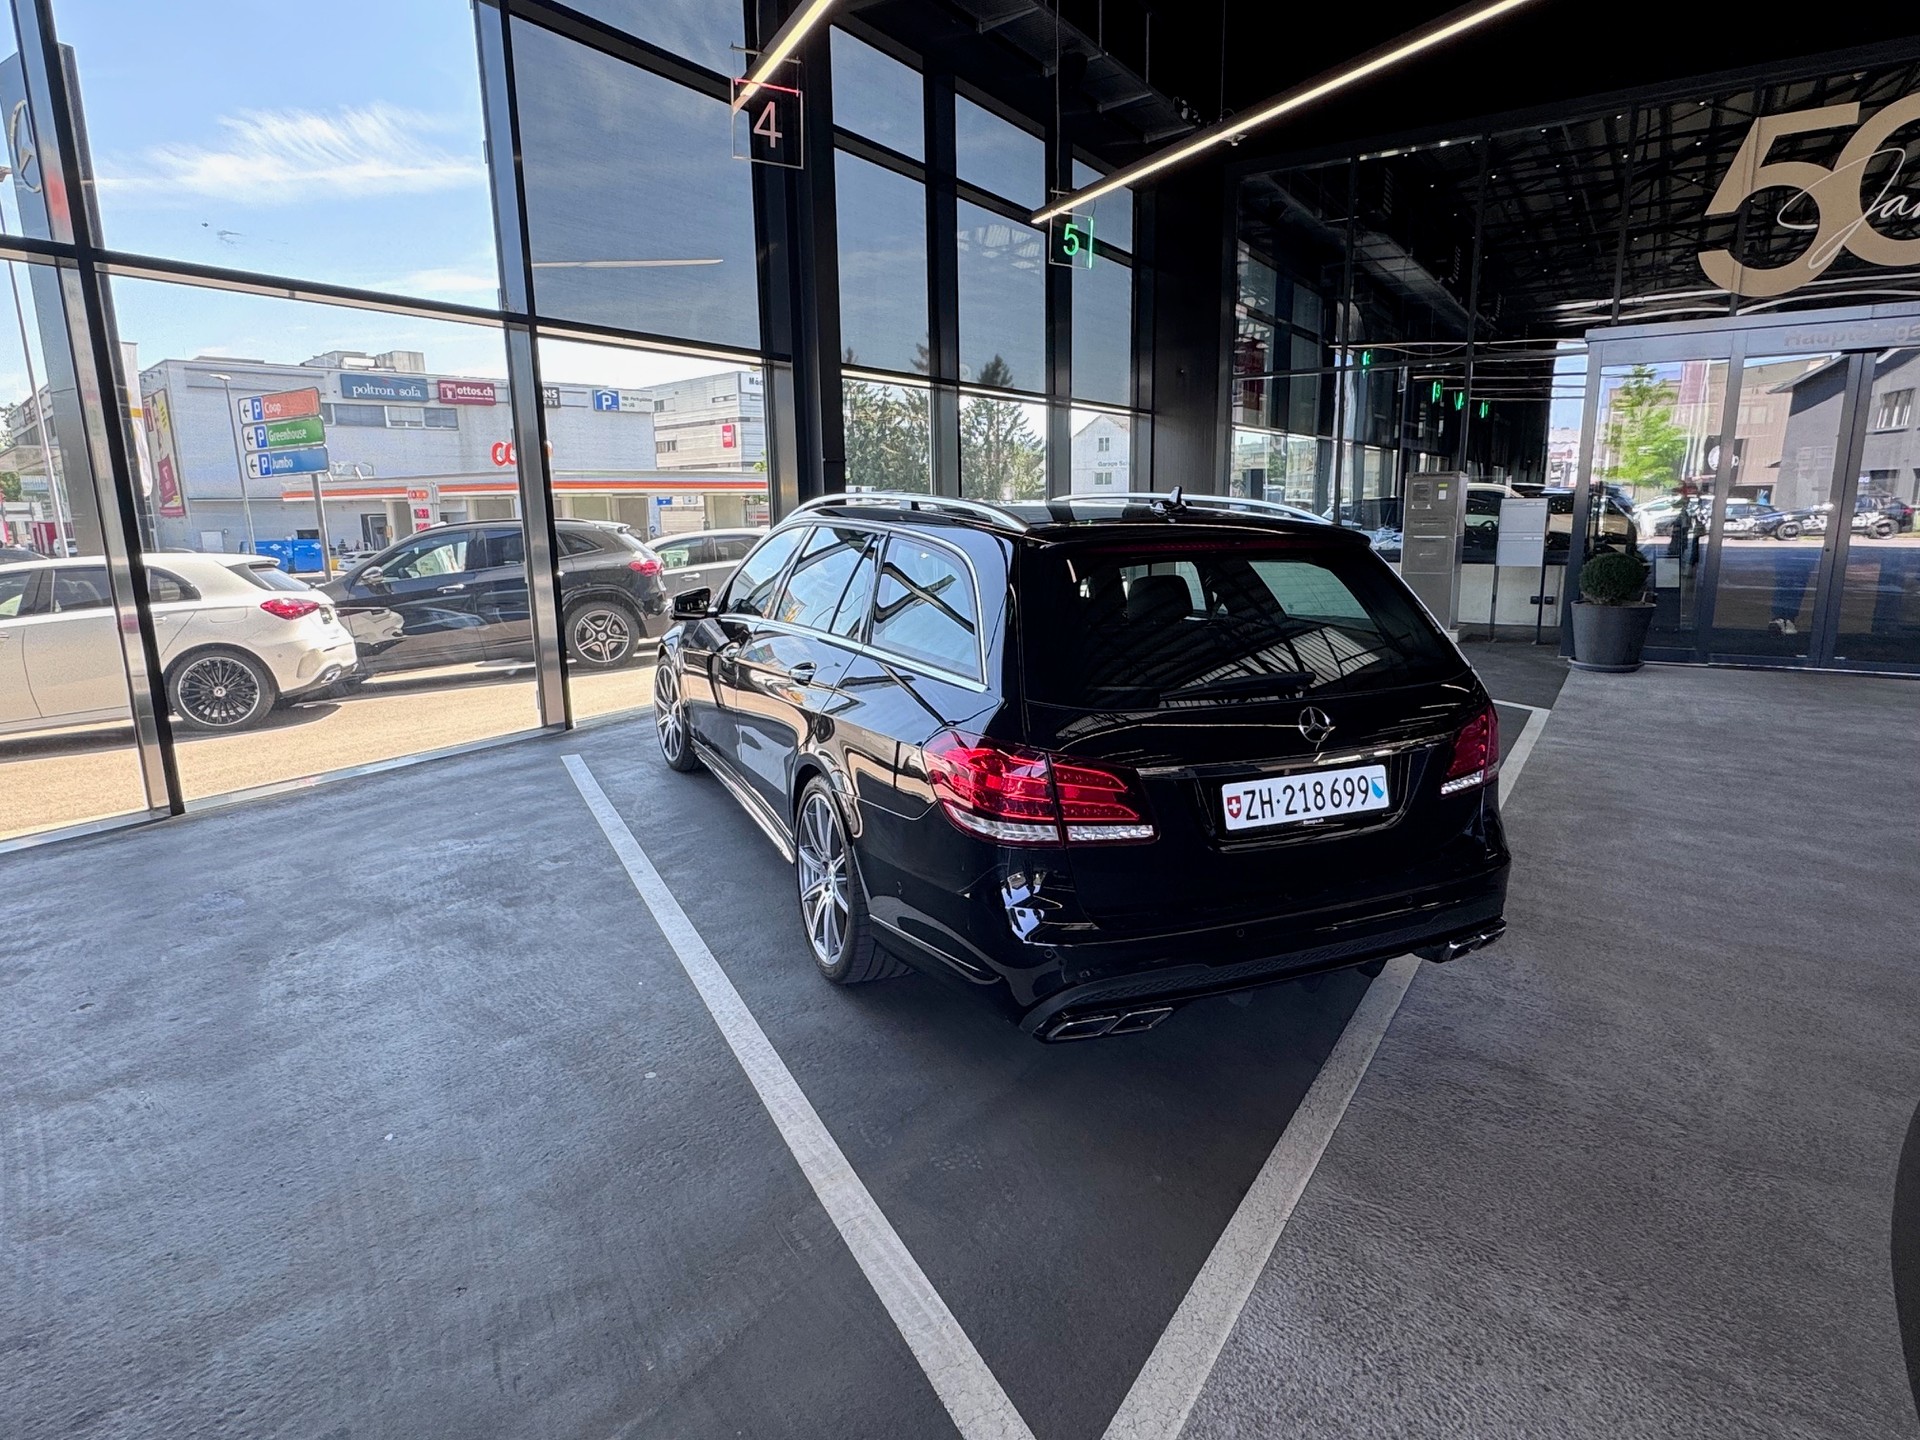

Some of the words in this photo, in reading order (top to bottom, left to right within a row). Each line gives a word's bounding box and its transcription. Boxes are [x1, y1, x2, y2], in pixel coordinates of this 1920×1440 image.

[753, 101, 783, 148] 4
[1777, 147, 1920, 269] Ja
[1063, 223, 1079, 256] 5
[457, 385, 494, 397] ottos.ch
[253, 401, 261, 418] P
[264, 401, 282, 415] Coop
[602, 394, 612, 410] P
[257, 429, 265, 447] P
[268, 428, 307, 442] Greenhouse
[261, 457, 268, 474] P
[271, 456, 294, 469] Jumbo
